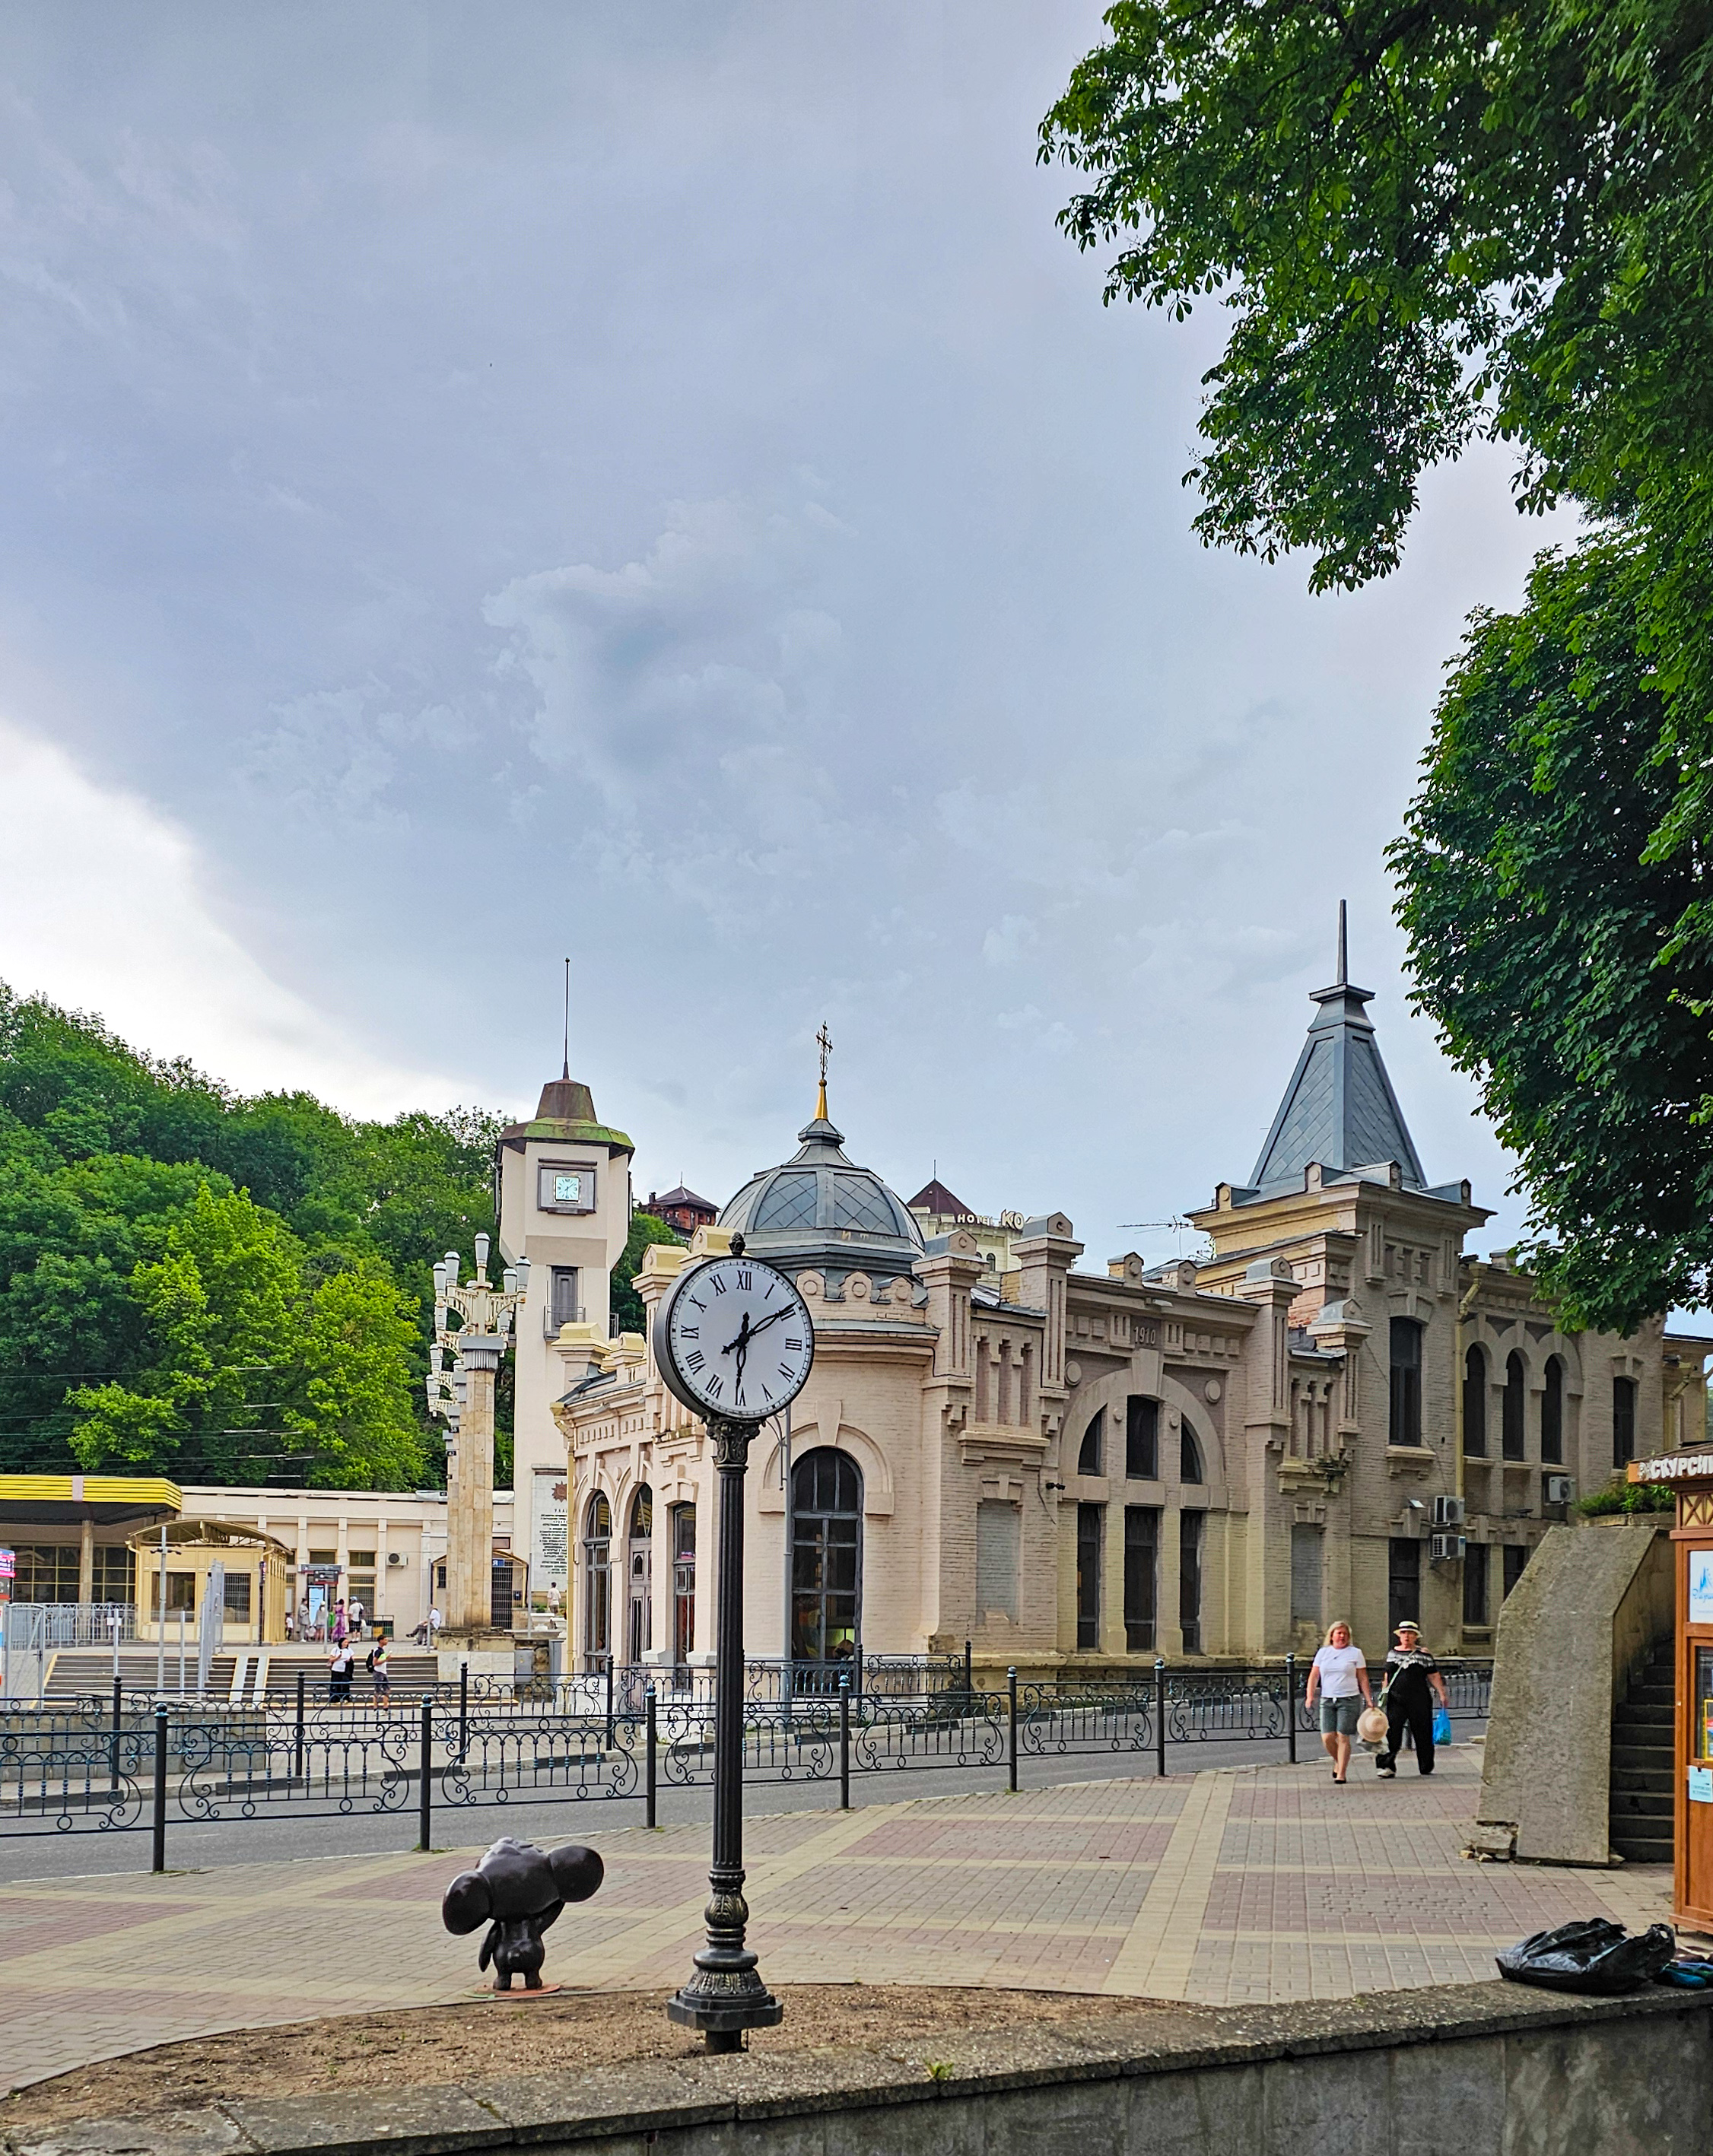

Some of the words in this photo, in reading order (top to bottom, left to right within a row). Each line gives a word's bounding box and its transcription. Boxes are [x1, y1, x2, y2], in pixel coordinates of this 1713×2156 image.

[709, 1274, 727, 1297] XI
[736, 1270, 752, 1291] XII
[764, 1283, 775, 1300] I
[688, 1294, 707, 1313] X
[681, 1324, 699, 1339] IX
[1134, 1326, 1156, 1345] 1910
[785, 1338, 802, 1351] III
[685, 1350, 707, 1376] VIII
[777, 1362, 796, 1383] IV
[705, 1373, 724, 1399] VII
[761, 1383, 774, 1402] V
